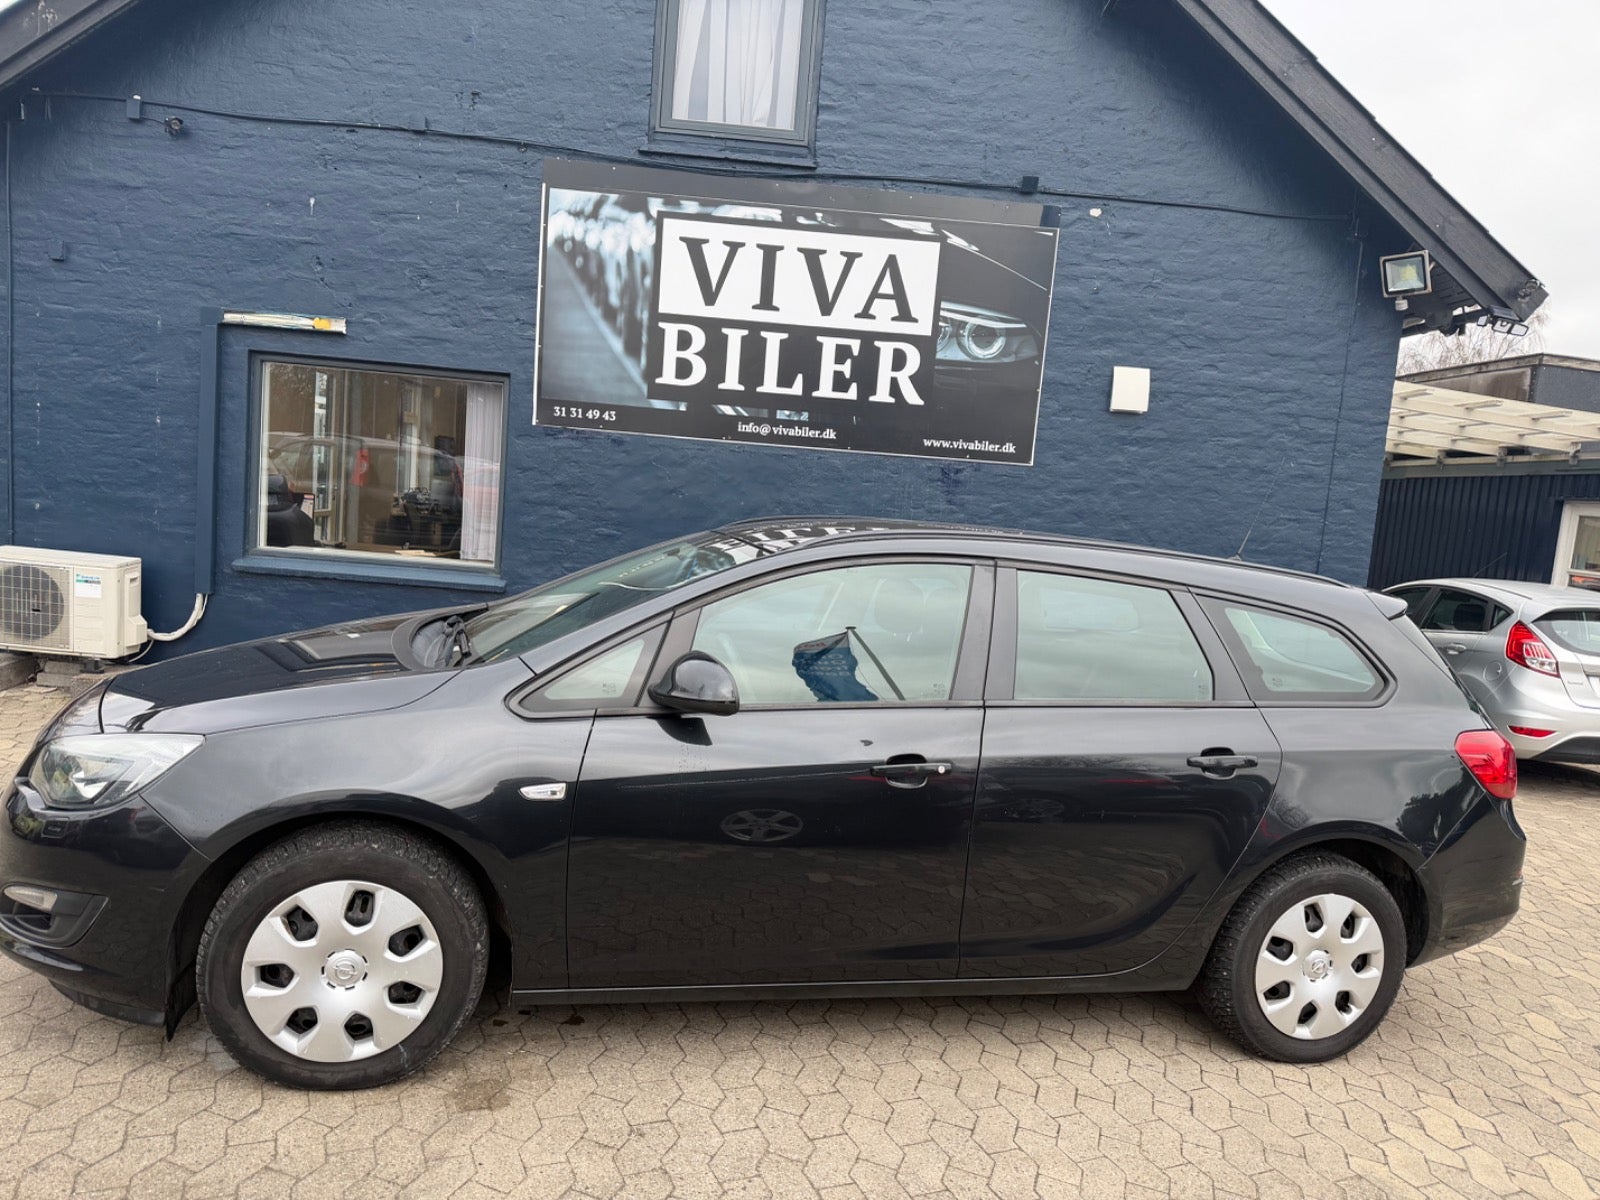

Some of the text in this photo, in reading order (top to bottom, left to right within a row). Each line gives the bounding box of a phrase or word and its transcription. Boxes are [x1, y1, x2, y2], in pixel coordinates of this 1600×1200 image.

[679, 237, 919, 323] VIVA
[655, 321, 925, 406] BILER
[553, 406, 616, 421] 31 31 49 43
[923, 438, 1016, 454] www.vivabiler.dk
